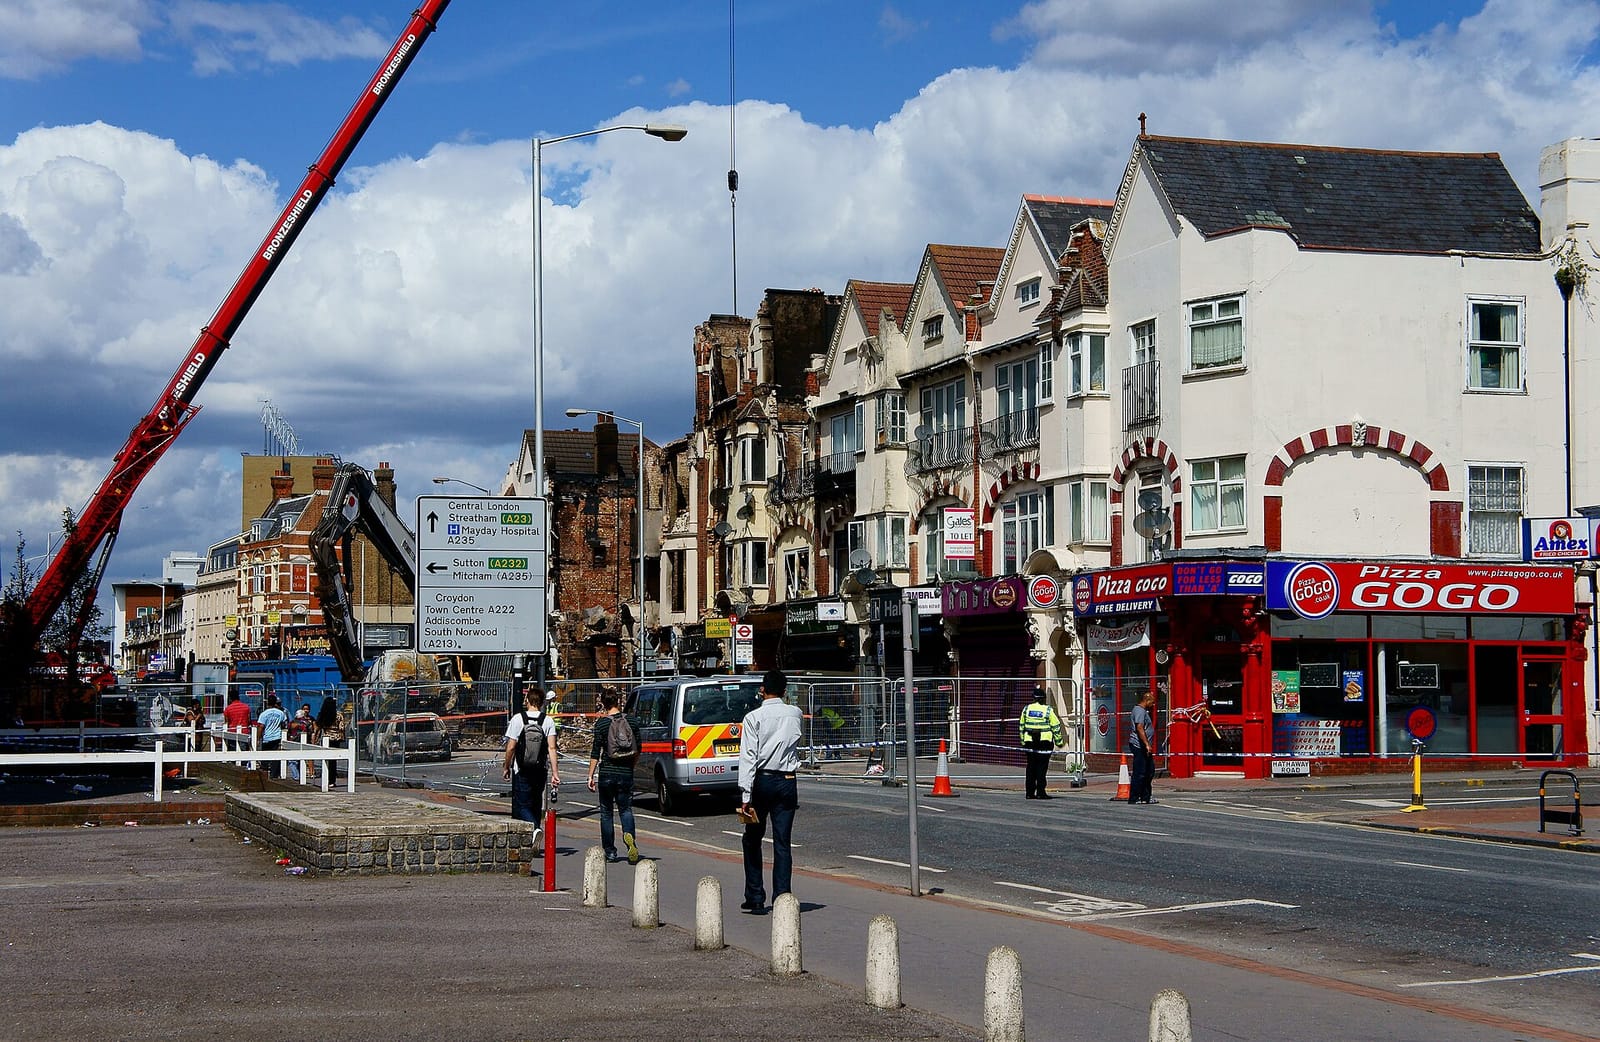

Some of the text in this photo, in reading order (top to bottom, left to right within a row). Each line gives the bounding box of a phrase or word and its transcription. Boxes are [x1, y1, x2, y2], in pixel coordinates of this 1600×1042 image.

[372, 34, 416, 95] BRONZESHIELD
[262, 189, 312, 260] BRONZESHIELD
[448, 502, 520, 511] Central London
[449, 514, 532, 524] Streatham (A23)
[946, 516, 972, 529] Gales
[462, 526, 497, 536] Mayday
[501, 527, 540, 537] Hospital
[950, 532, 972, 540] TO LET
[448, 536, 475, 544] A235
[1534, 536, 1588, 551] Amex
[453, 558, 527, 568] Sutton (A232)
[1209, 566, 1222, 574] GO
[1360, 566, 1442, 579] Pizza
[1467, 569, 1563, 580] www.pizzagogo.co.uk
[452, 572, 533, 581] Mitcham (A235)
[1178, 576, 1222, 584] FOR LESS
[1228, 574, 1264, 584] GOGO
[1096, 575, 1168, 597] Pizza GOGO
[1298, 578, 1316, 588] Pizza
[1034, 586, 1055, 597] GOGO
[1296, 580, 1332, 600] GOGO
[435, 594, 474, 604] Croydon
[1352, 581, 1520, 610] GOGO
[425, 606, 515, 614] Town Centre A222
[1095, 604, 1114, 614] FREE
[1116, 600, 1154, 612] DELIVERY
[425, 616, 481, 625] Addiscombe
[424, 628, 498, 636] South Norwood
[1277, 720, 1364, 728] SPECIAL OFFERS
[695, 766, 725, 774] POLICE
